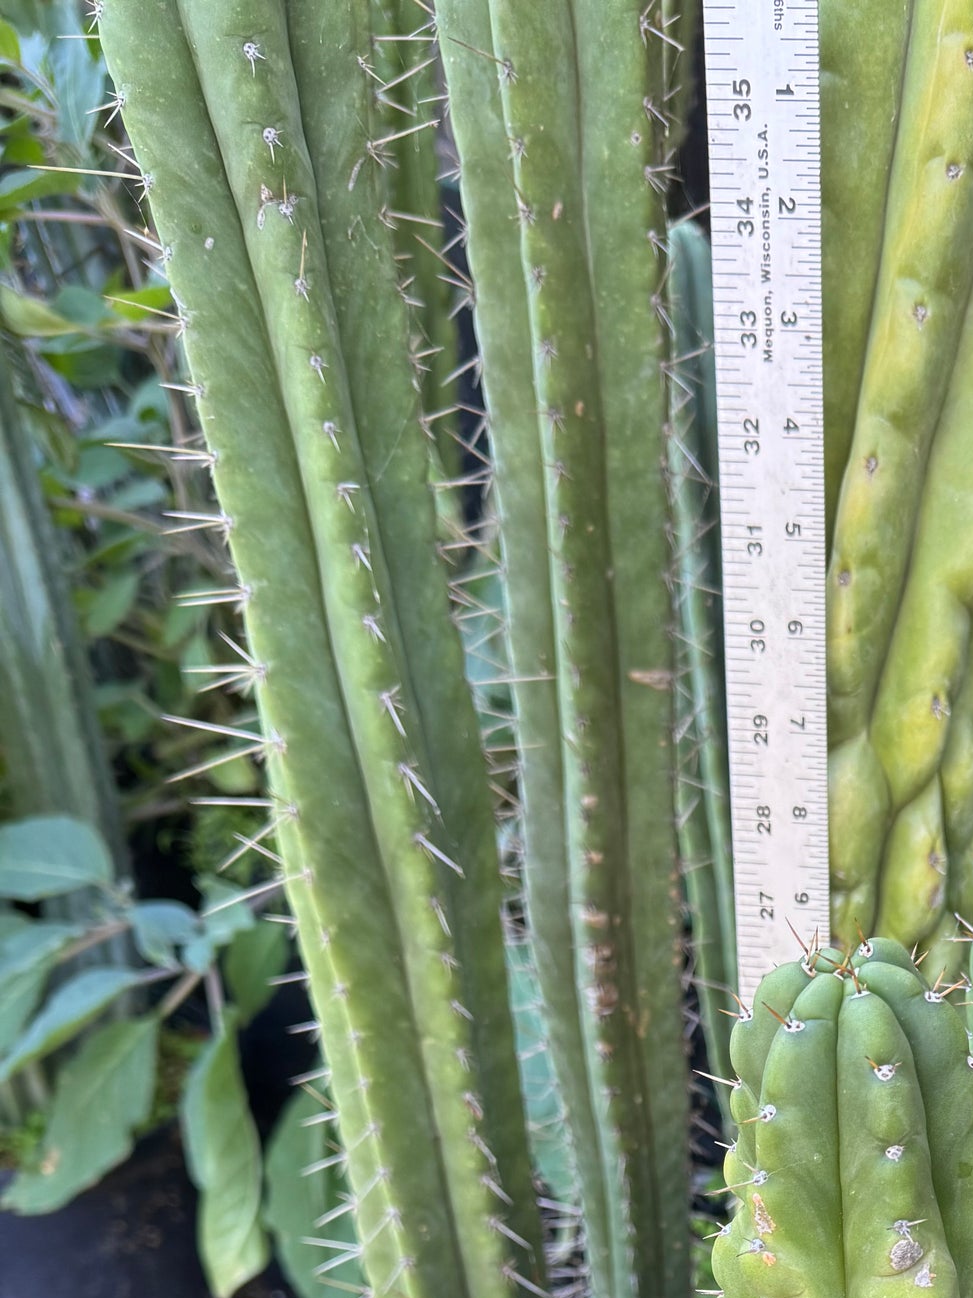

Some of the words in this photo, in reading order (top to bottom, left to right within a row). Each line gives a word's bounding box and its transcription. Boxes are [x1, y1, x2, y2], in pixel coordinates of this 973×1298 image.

[732, 78, 752, 122] 35
[775, 83, 795, 96] 1
[757, 123, 770, 180] U.S.A.
[736, 196, 755, 238] 34
[778, 196, 796, 214] 2
[758, 187, 772, 284] Wisconsin,
[740, 310, 757, 349] 33
[762, 290, 774, 363] Mequon,
[780, 310, 798, 327] 3
[743, 417, 760, 455] 32
[783, 417, 800, 435] 4
[746, 526, 763, 557] 31
[785, 522, 801, 537] 5
[749, 619, 766, 654] 30
[753, 714, 769, 746] 29
[790, 716, 806, 730] 7
[756, 804, 772, 835] 28
[792, 806, 808, 820] 8
[759, 891, 774, 920] 27
